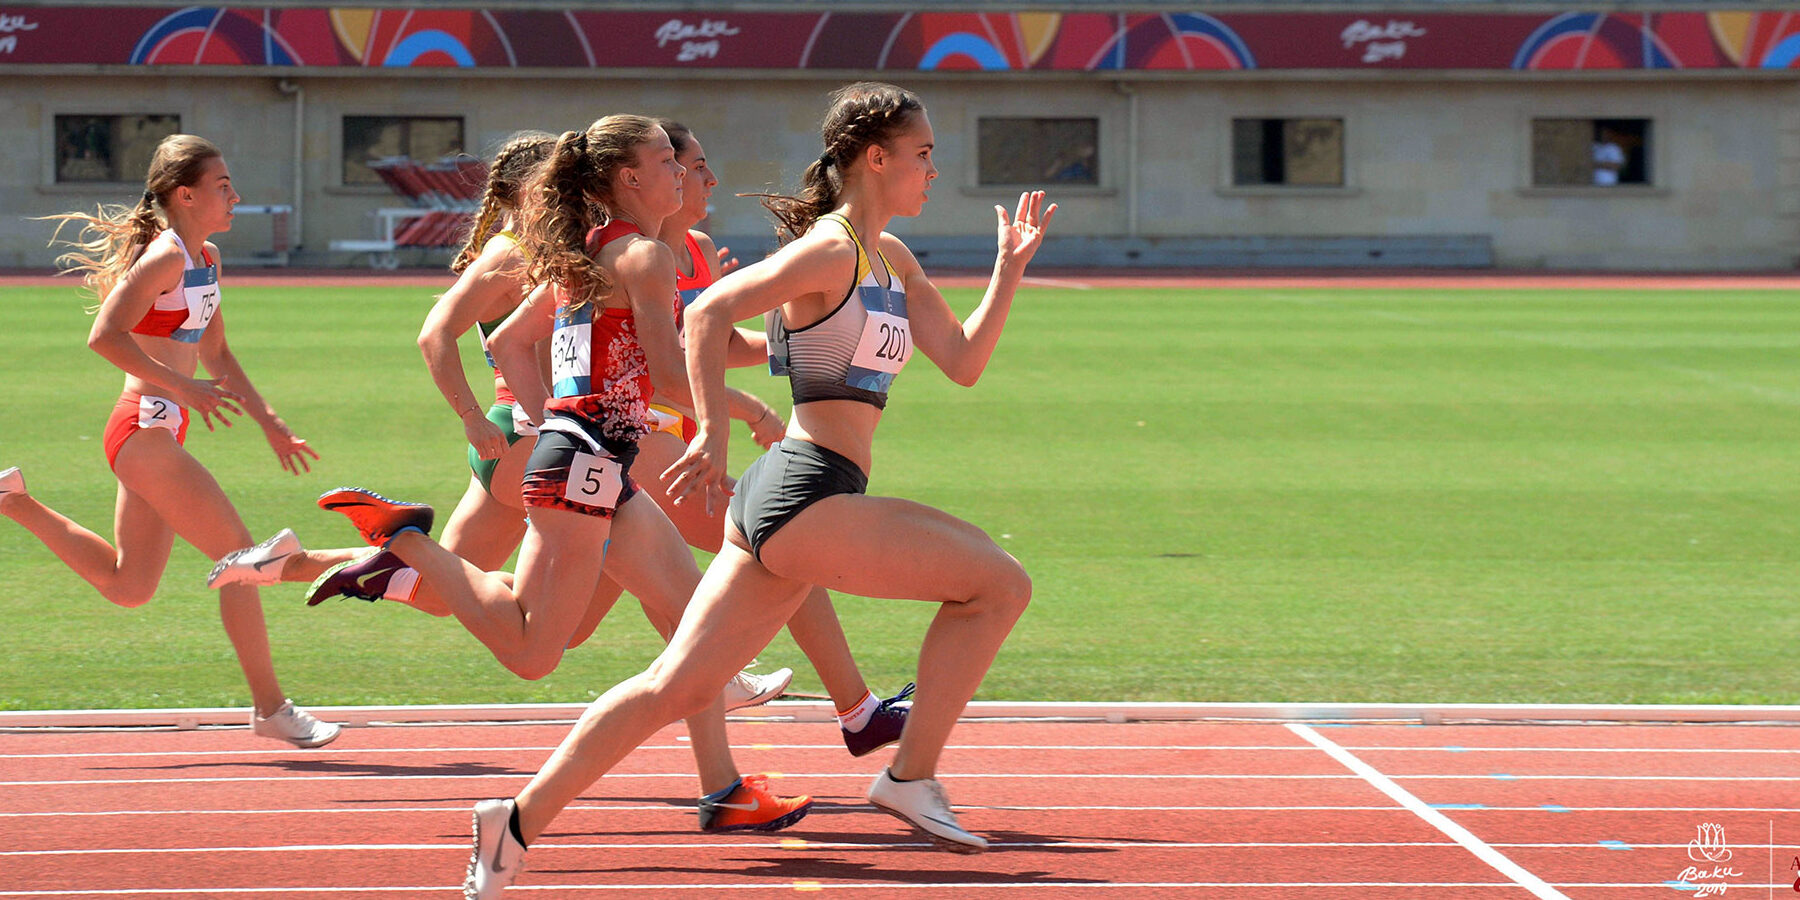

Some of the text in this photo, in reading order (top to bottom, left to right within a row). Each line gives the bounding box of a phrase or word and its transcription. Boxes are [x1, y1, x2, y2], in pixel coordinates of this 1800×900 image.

[0, 14, 39, 32] ku
[655, 19, 740, 48] Baku
[1341, 20, 1427, 48] Baku
[676, 40, 719, 61] 2019
[1361, 40, 1406, 62] 2019
[200, 290, 216, 322] 75
[876, 323, 906, 362] 201
[152, 400, 167, 420] 2
[581, 467, 603, 496] 5
